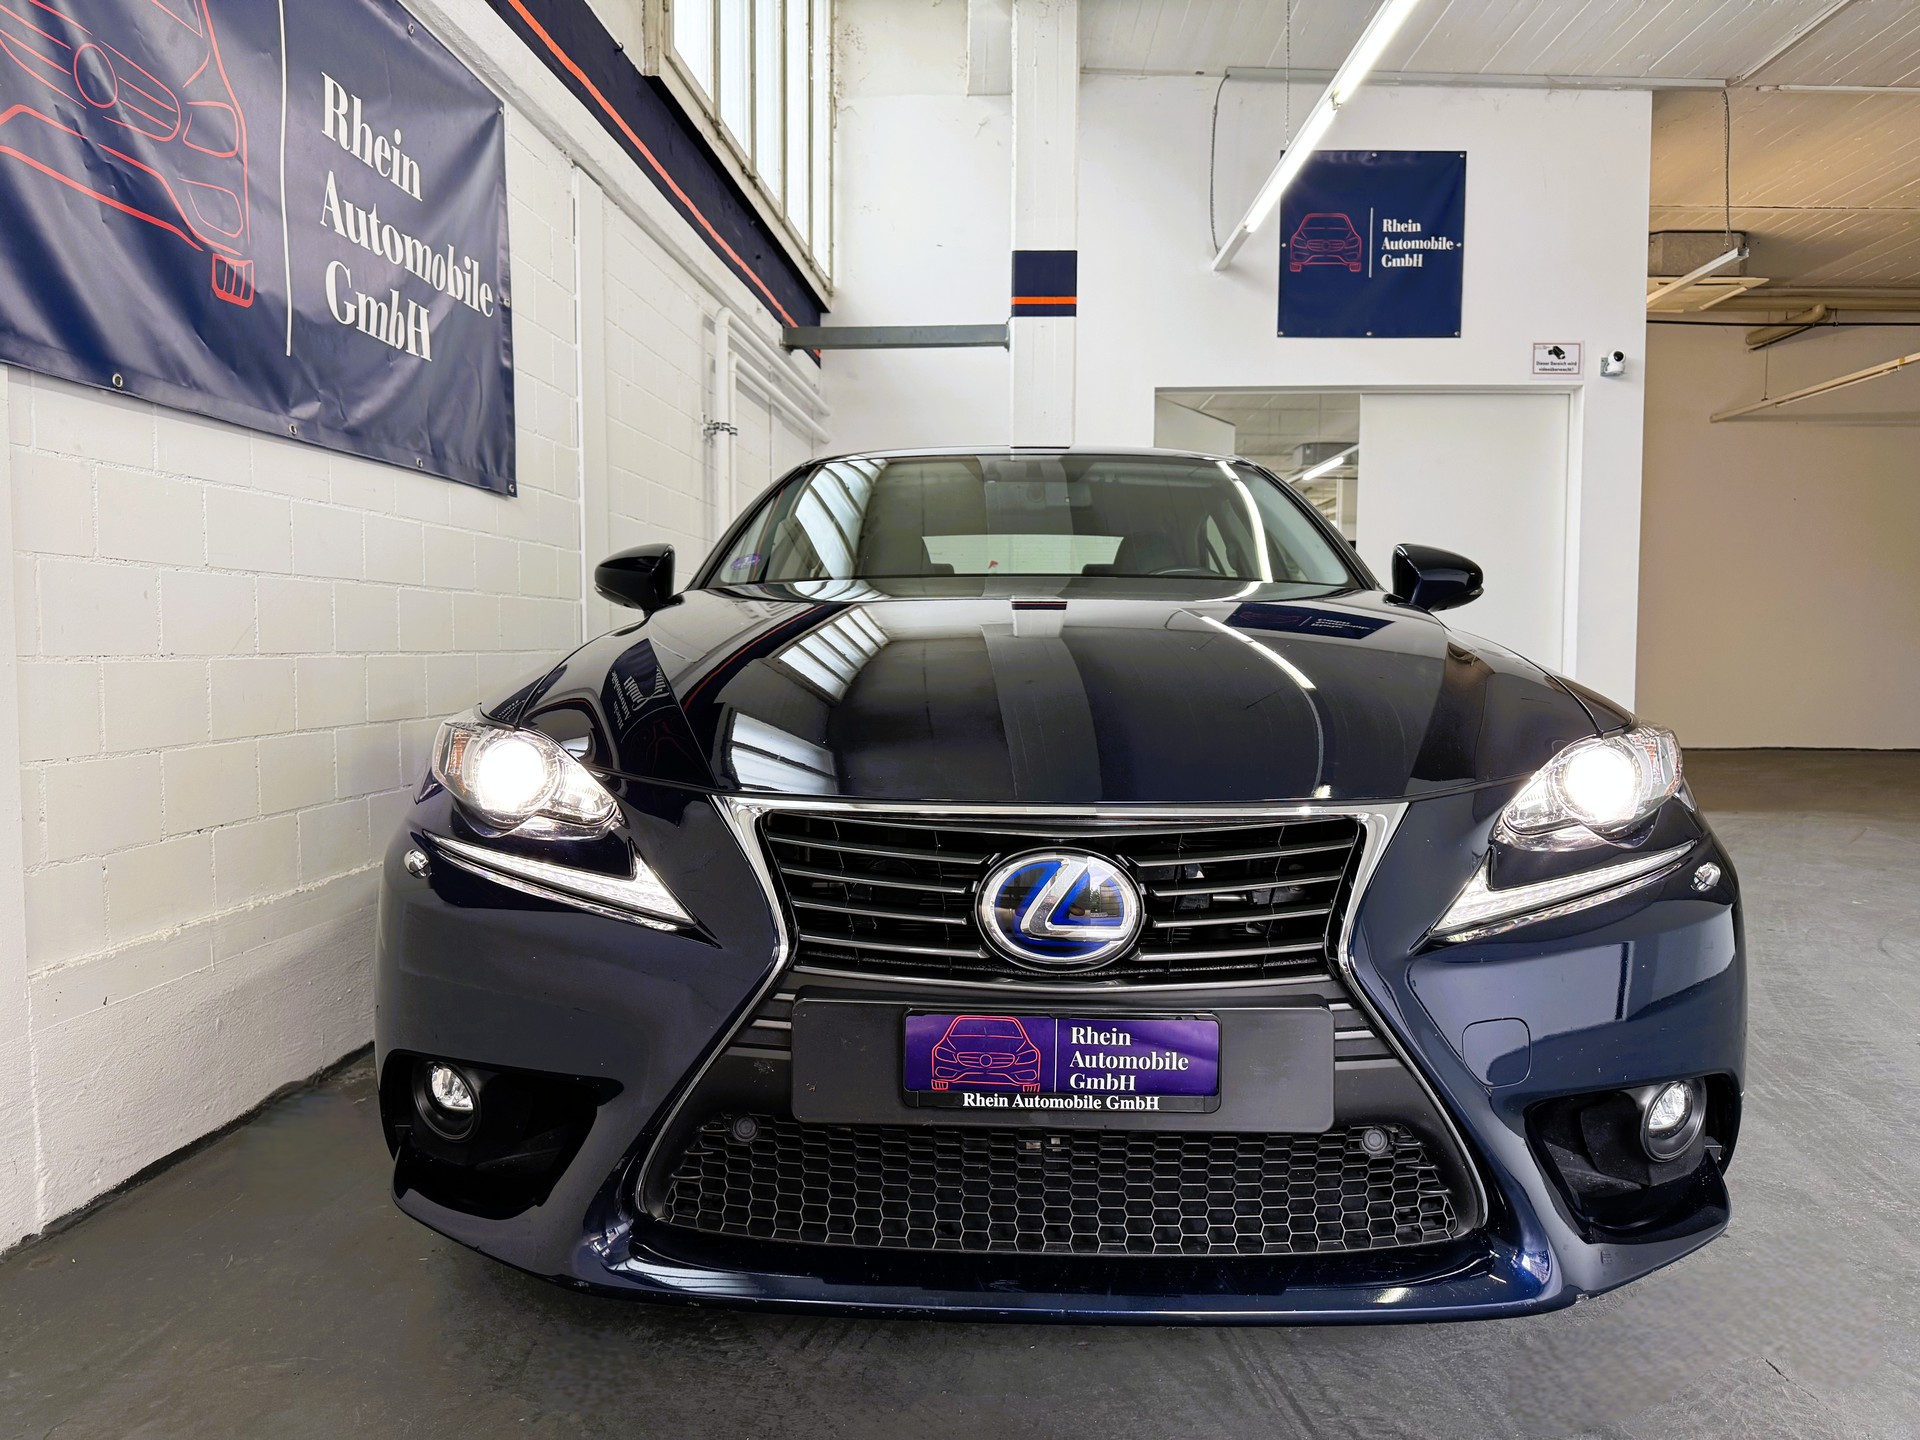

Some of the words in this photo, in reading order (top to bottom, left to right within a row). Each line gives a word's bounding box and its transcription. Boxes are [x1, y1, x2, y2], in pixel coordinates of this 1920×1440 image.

[321, 72, 423, 202] Rhein
[1382, 219, 1421, 232] Rhein
[320, 170, 494, 318] Automobile
[1381, 237, 1454, 250] Automobile
[1381, 253, 1422, 267] GmbH
[325, 260, 432, 361] GmbH
[1070, 1026, 1131, 1046] Rhein
[1069, 1051, 1189, 1071] Automobile
[1069, 1072, 1136, 1092] GmbH
[962, 1092, 1008, 1108] Rhein
[1012, 1093, 1102, 1110] Automobile
[1106, 1094, 1160, 1111] GmbH
